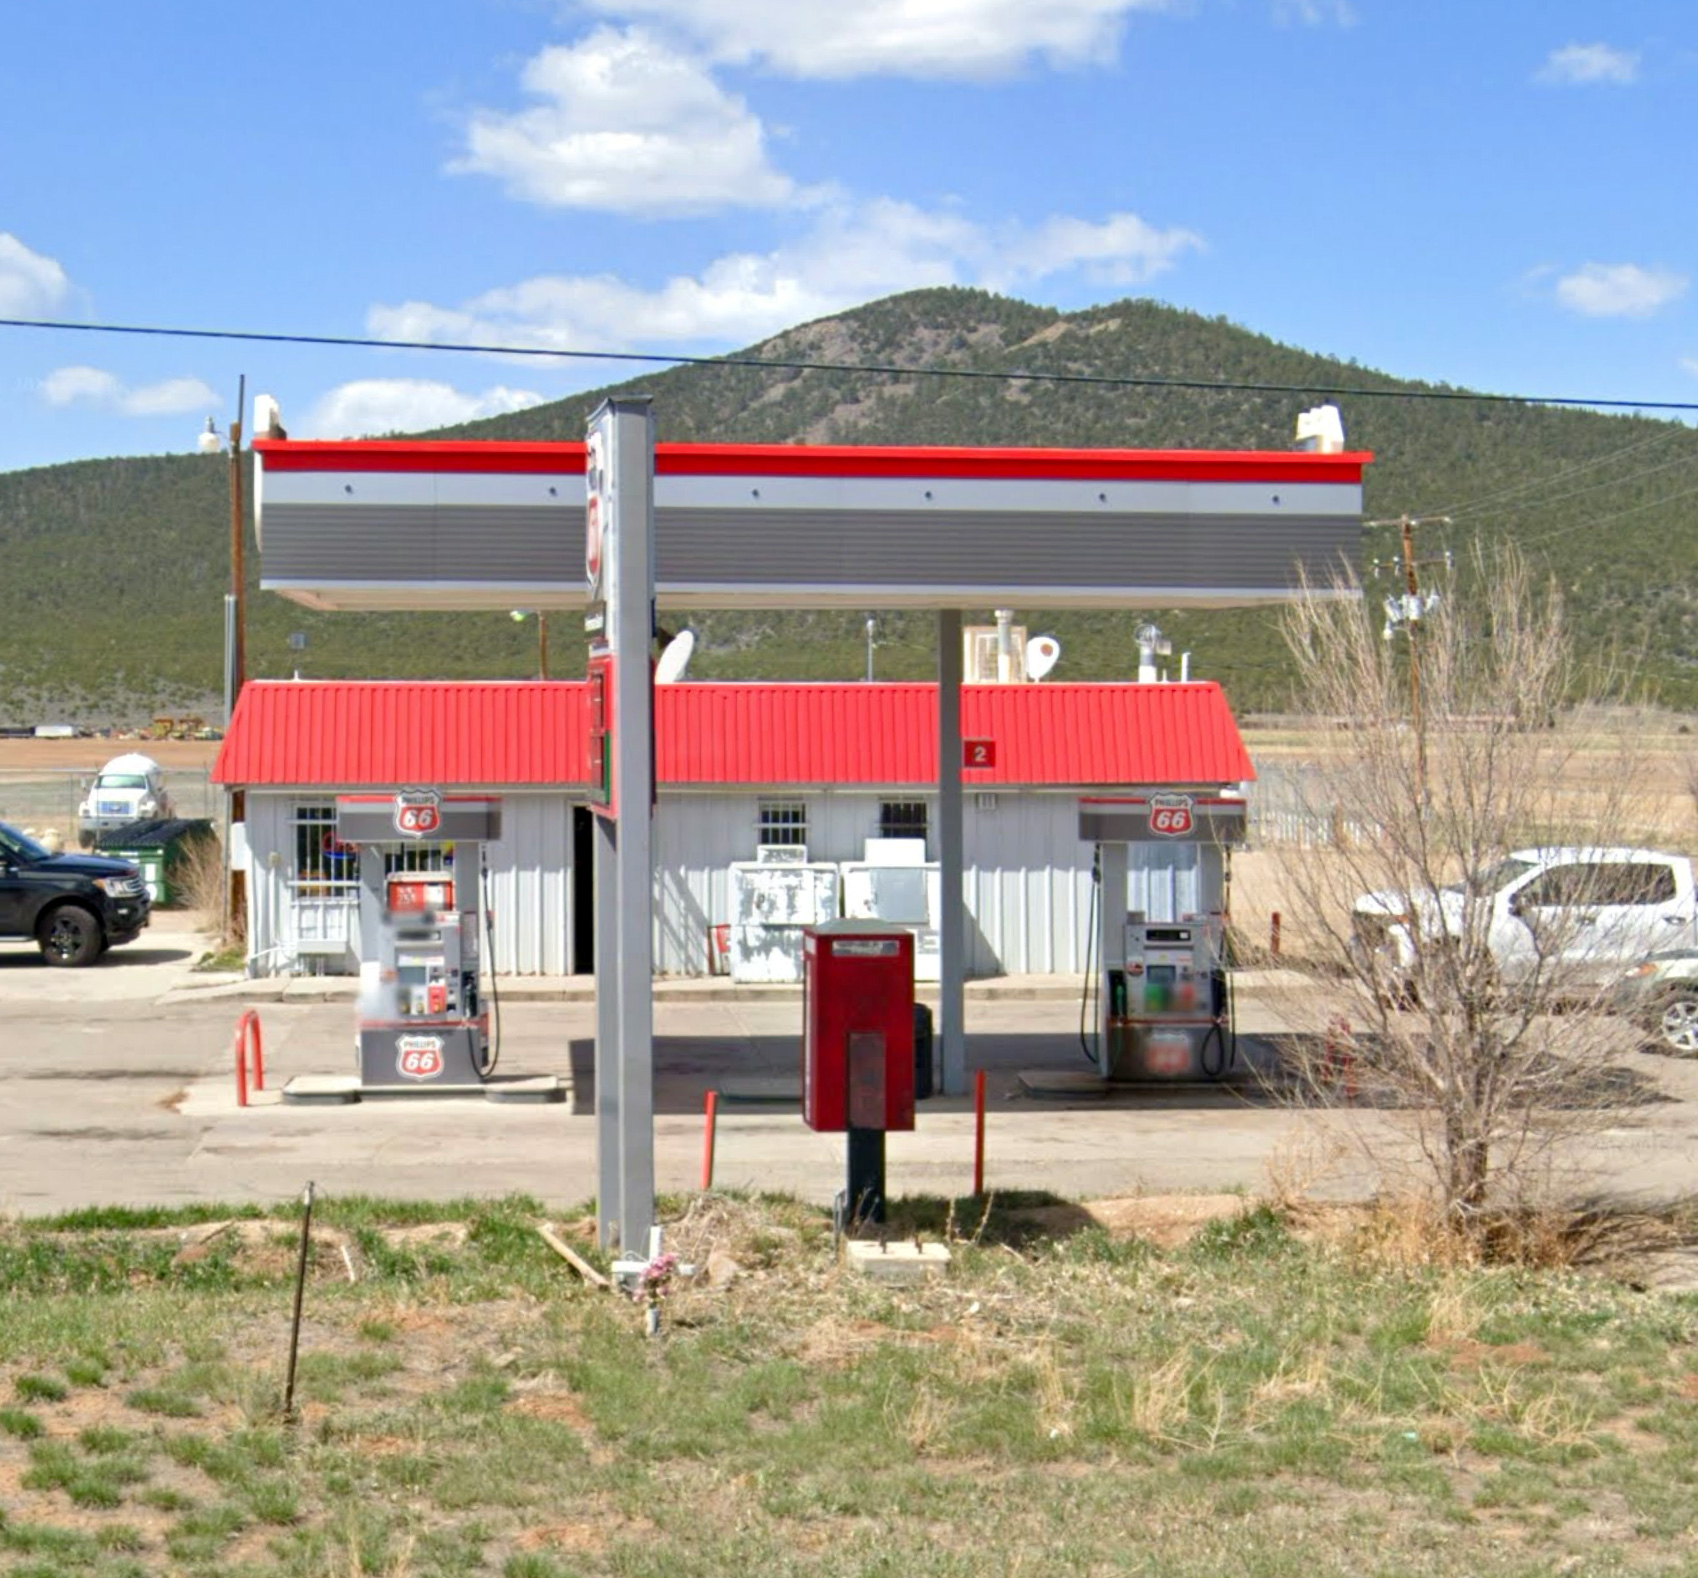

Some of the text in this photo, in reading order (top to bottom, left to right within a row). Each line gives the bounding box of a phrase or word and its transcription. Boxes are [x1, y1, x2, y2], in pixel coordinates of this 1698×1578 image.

[974, 745, 987, 762] 2
[403, 809, 433, 827] 66
[1156, 811, 1186, 829] 66
[405, 1052, 434, 1070] 66
